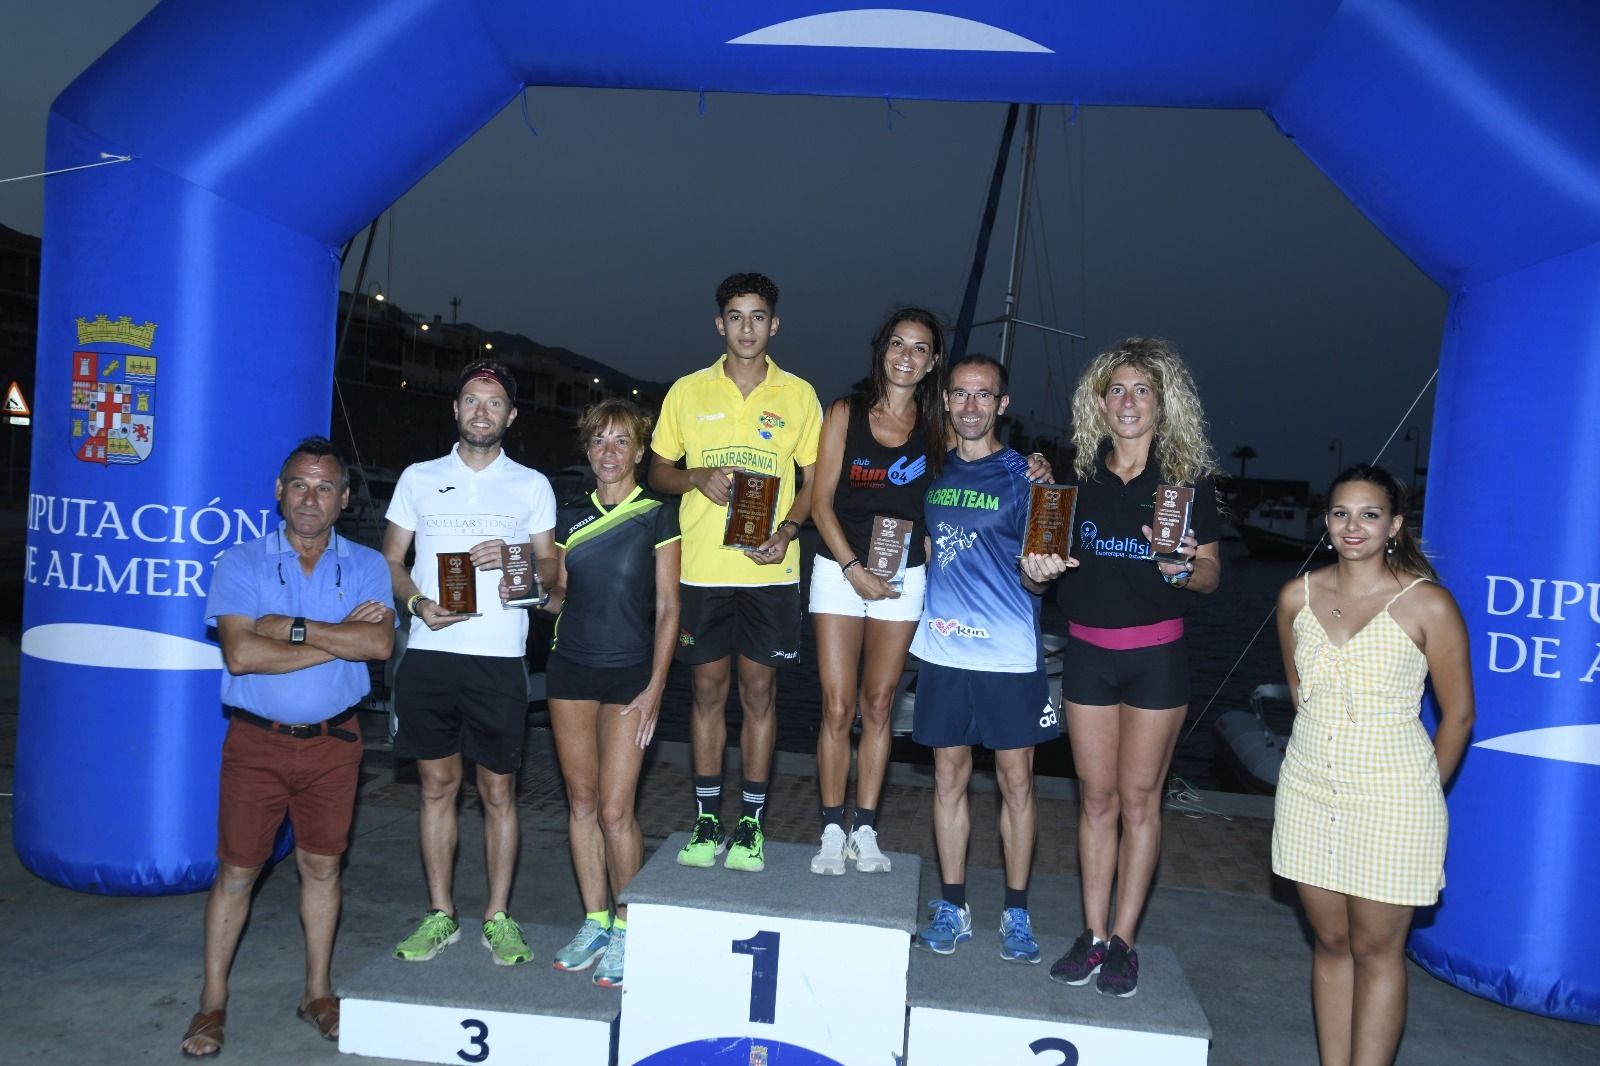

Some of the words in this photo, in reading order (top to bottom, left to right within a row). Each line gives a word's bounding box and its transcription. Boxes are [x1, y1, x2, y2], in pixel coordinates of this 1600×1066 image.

[850, 465, 887, 481] Run
[962, 489, 999, 511] TEAM
[1487, 632, 1561, 679] DE
[731, 930, 781, 1024] 1
[456, 1018, 489, 1063] 3
